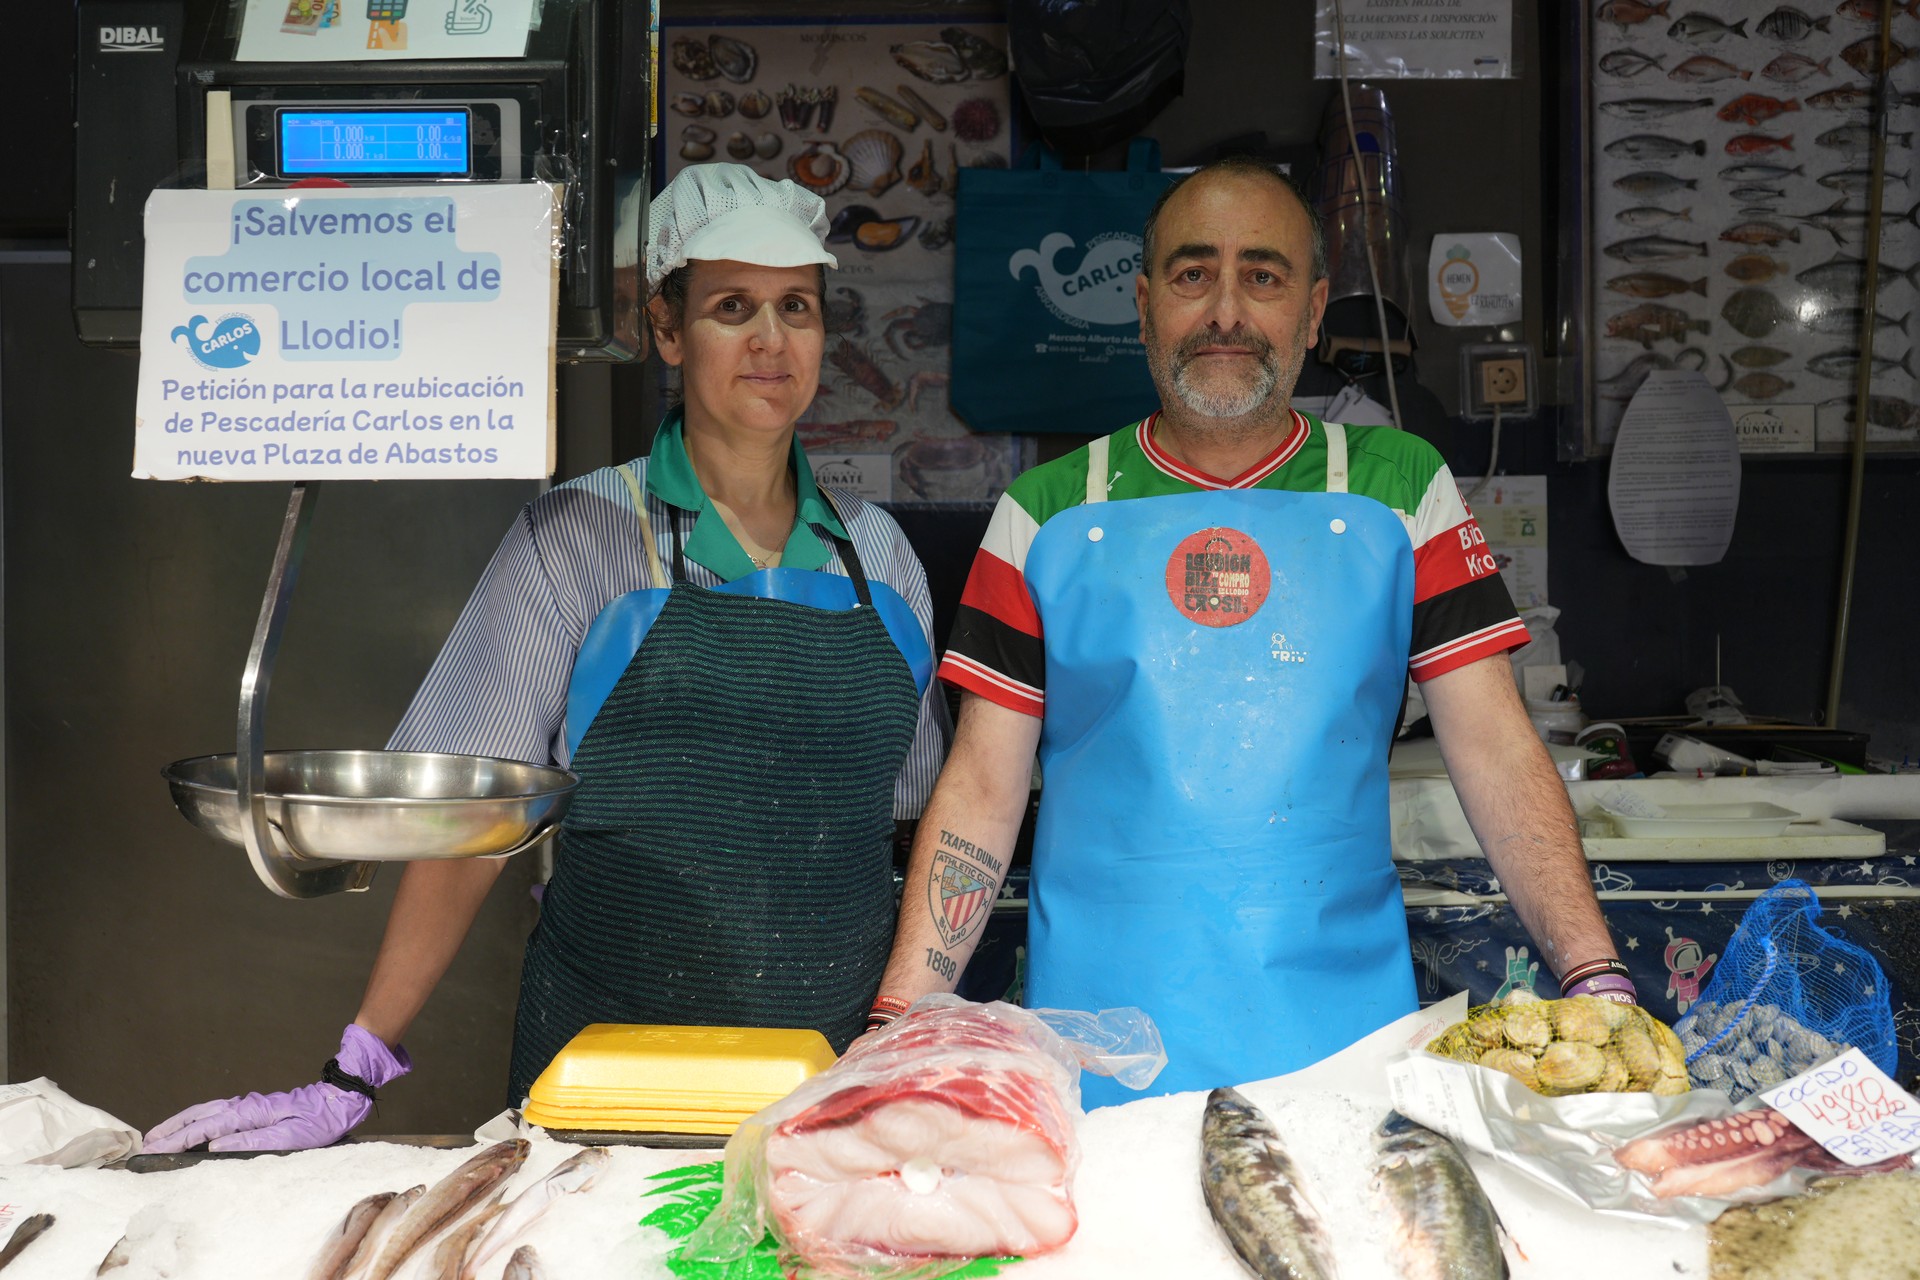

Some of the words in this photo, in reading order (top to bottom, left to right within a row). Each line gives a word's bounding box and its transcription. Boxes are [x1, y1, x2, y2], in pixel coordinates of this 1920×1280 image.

[1331, 14, 1419, 24] RCLAMACIONES
[1421, 15, 1429, 24] A
[1431, 13, 1498, 24] DISPOSICIÓN
[100, 27, 164, 44] DIBAL
[1344, 31, 1360, 39] DE
[1361, 31, 1407, 41] QUIENES
[1409, 31, 1428, 40] LAS
[1430, 31, 1485, 40] SOLICITEN
[334, 126, 364, 142] 0.000
[417, 126, 441, 142] 0.00
[334, 143, 364, 159] 0.000
[417, 143, 441, 159] 0.00
[234, 206, 413, 245] ¡Salvemos
[424, 204, 455, 233] el
[184, 262, 349, 293] comercio
[361, 258, 446, 292] local
[457, 260, 501, 291] de
[1063, 252, 1142, 296] CARLOS
[1447, 273, 1471, 283] HEMEN
[201, 322, 253, 354] CARLOS
[281, 318, 400, 350] Llodio!
[1048, 333, 1086, 343] Mercado
[1087, 334, 1121, 344] Alberto
[162, 378, 266, 401] Petición
[273, 381, 333, 403] para
[341, 378, 367, 399] la
[373, 376, 524, 399] reubicación
[164, 411, 194, 434] de
[200, 409, 346, 433] Pescadería
[352, 409, 443, 432] Carlos
[449, 413, 480, 431] en
[487, 409, 514, 431] la
[1736, 425, 1784, 434] EUNATE
[177, 448, 256, 466] nueva
[263, 443, 343, 465] Plaza
[348, 443, 379, 464] de
[385, 443, 498, 464] Abastos
[1219, 573, 1250, 588] COMPRO
[940, 830, 1002, 875] TXAPELDUNAK
[937, 854, 976, 880] ATHLETIC
[976, 872, 995, 890] CLUB
[938, 915, 967, 944] BILBAO
[926, 947, 957, 982] 1898
